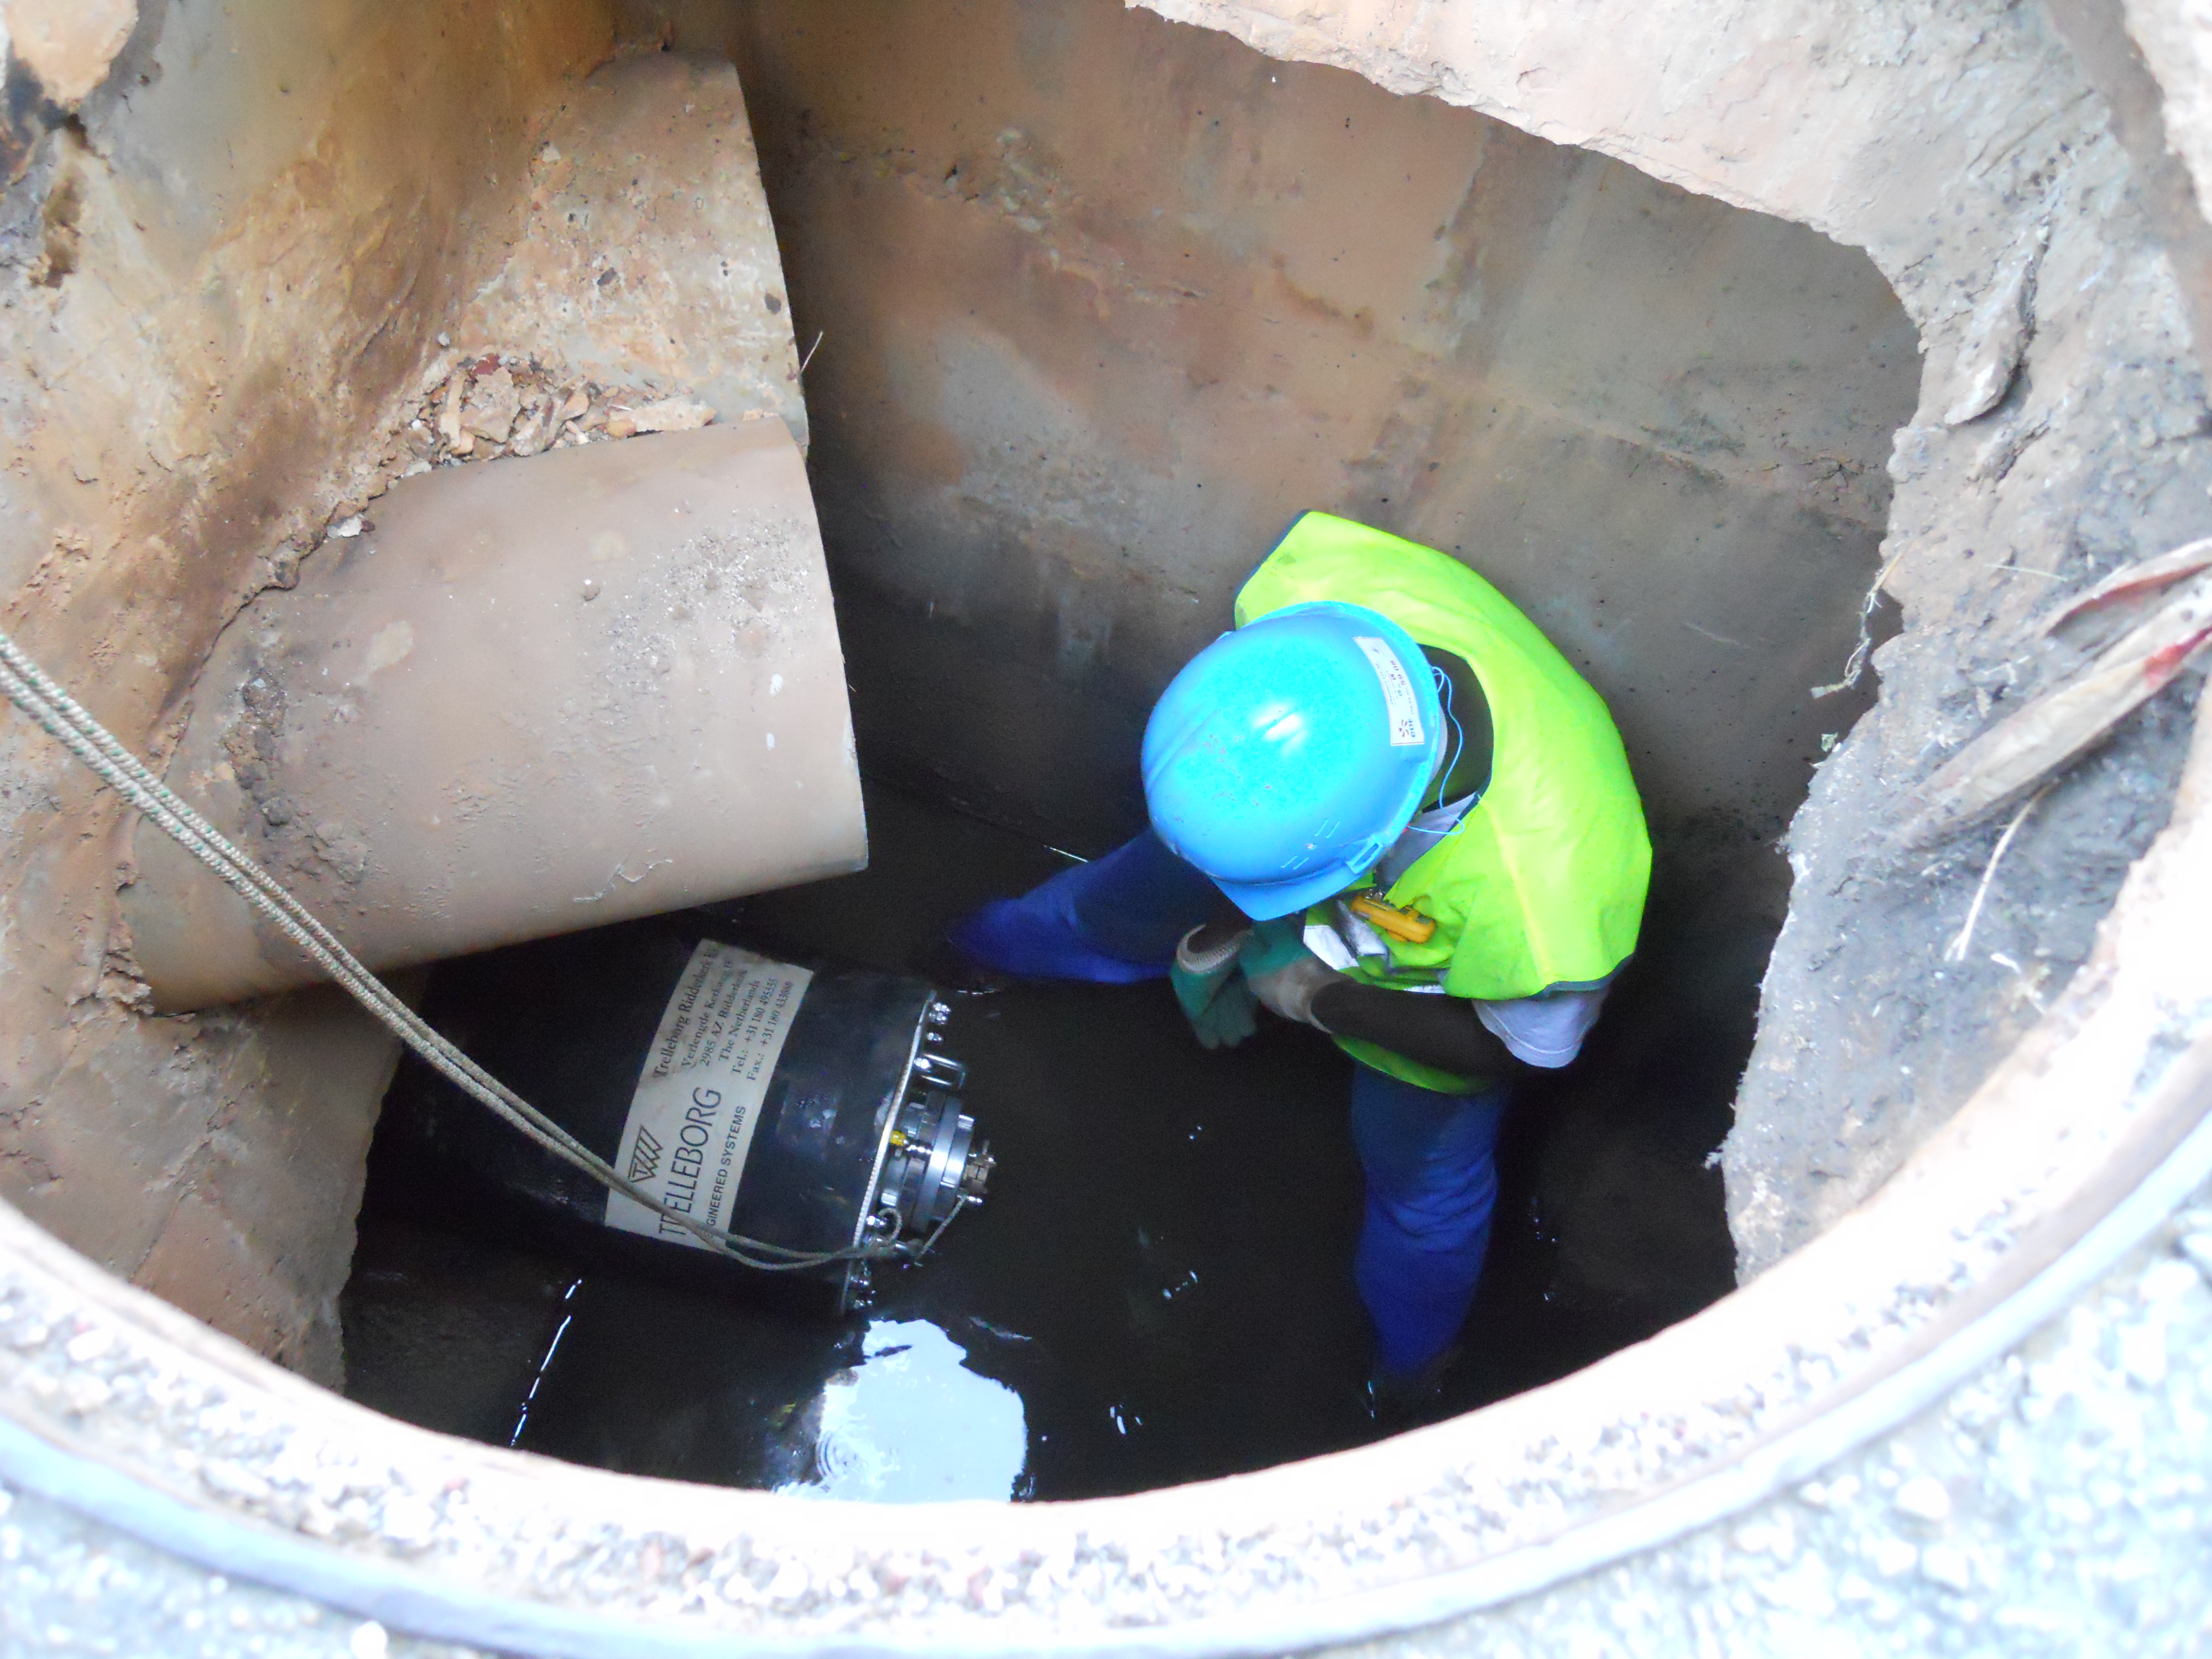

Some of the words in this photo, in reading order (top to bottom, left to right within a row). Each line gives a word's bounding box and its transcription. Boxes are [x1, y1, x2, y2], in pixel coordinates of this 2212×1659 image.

[654, 1016, 689, 1078] Trelleborg
[681, 1013, 709, 1068] Verlengde
[700, 1040, 717, 1067] 2985
[711, 1021, 724, 1039] AZ
[718, 1039, 734, 1061] The
[728, 980, 760, 1037] Netherlands
[731, 1050, 748, 1074] Tel.:
[745, 1025, 758, 1043] +31
[752, 1007, 765, 1022] 180
[747, 1053, 765, 1081] Fax.:
[760, 1027, 774, 1046] +31
[768, 1010, 781, 1026] 180
[721, 1105, 746, 1166] SYSTEMS
